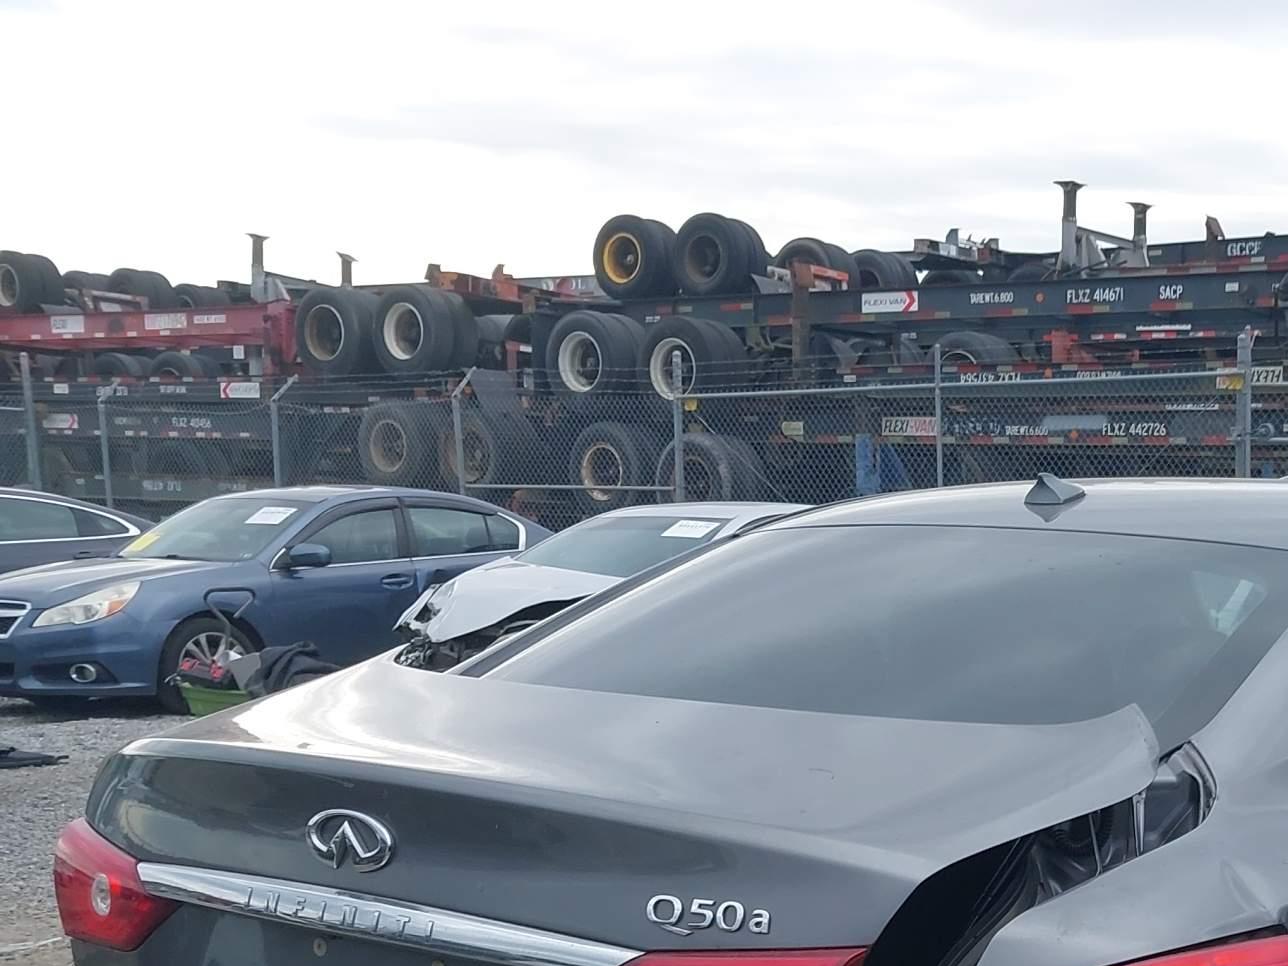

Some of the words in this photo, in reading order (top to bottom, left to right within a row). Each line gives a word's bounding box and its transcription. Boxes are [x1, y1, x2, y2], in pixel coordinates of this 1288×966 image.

[1066, 289, 1091, 304] FLXZ
[1092, 287, 1125, 303] 414671
[1159, 284, 1184, 300] SACP
[882, 418, 936, 435] FLEXI-VAN
[1102, 422, 1127, 437] FLXZ
[1129, 421, 1168, 437] 442726
[242, 886, 436, 944] INFINITI
[646, 894, 771, 937] Q50a
